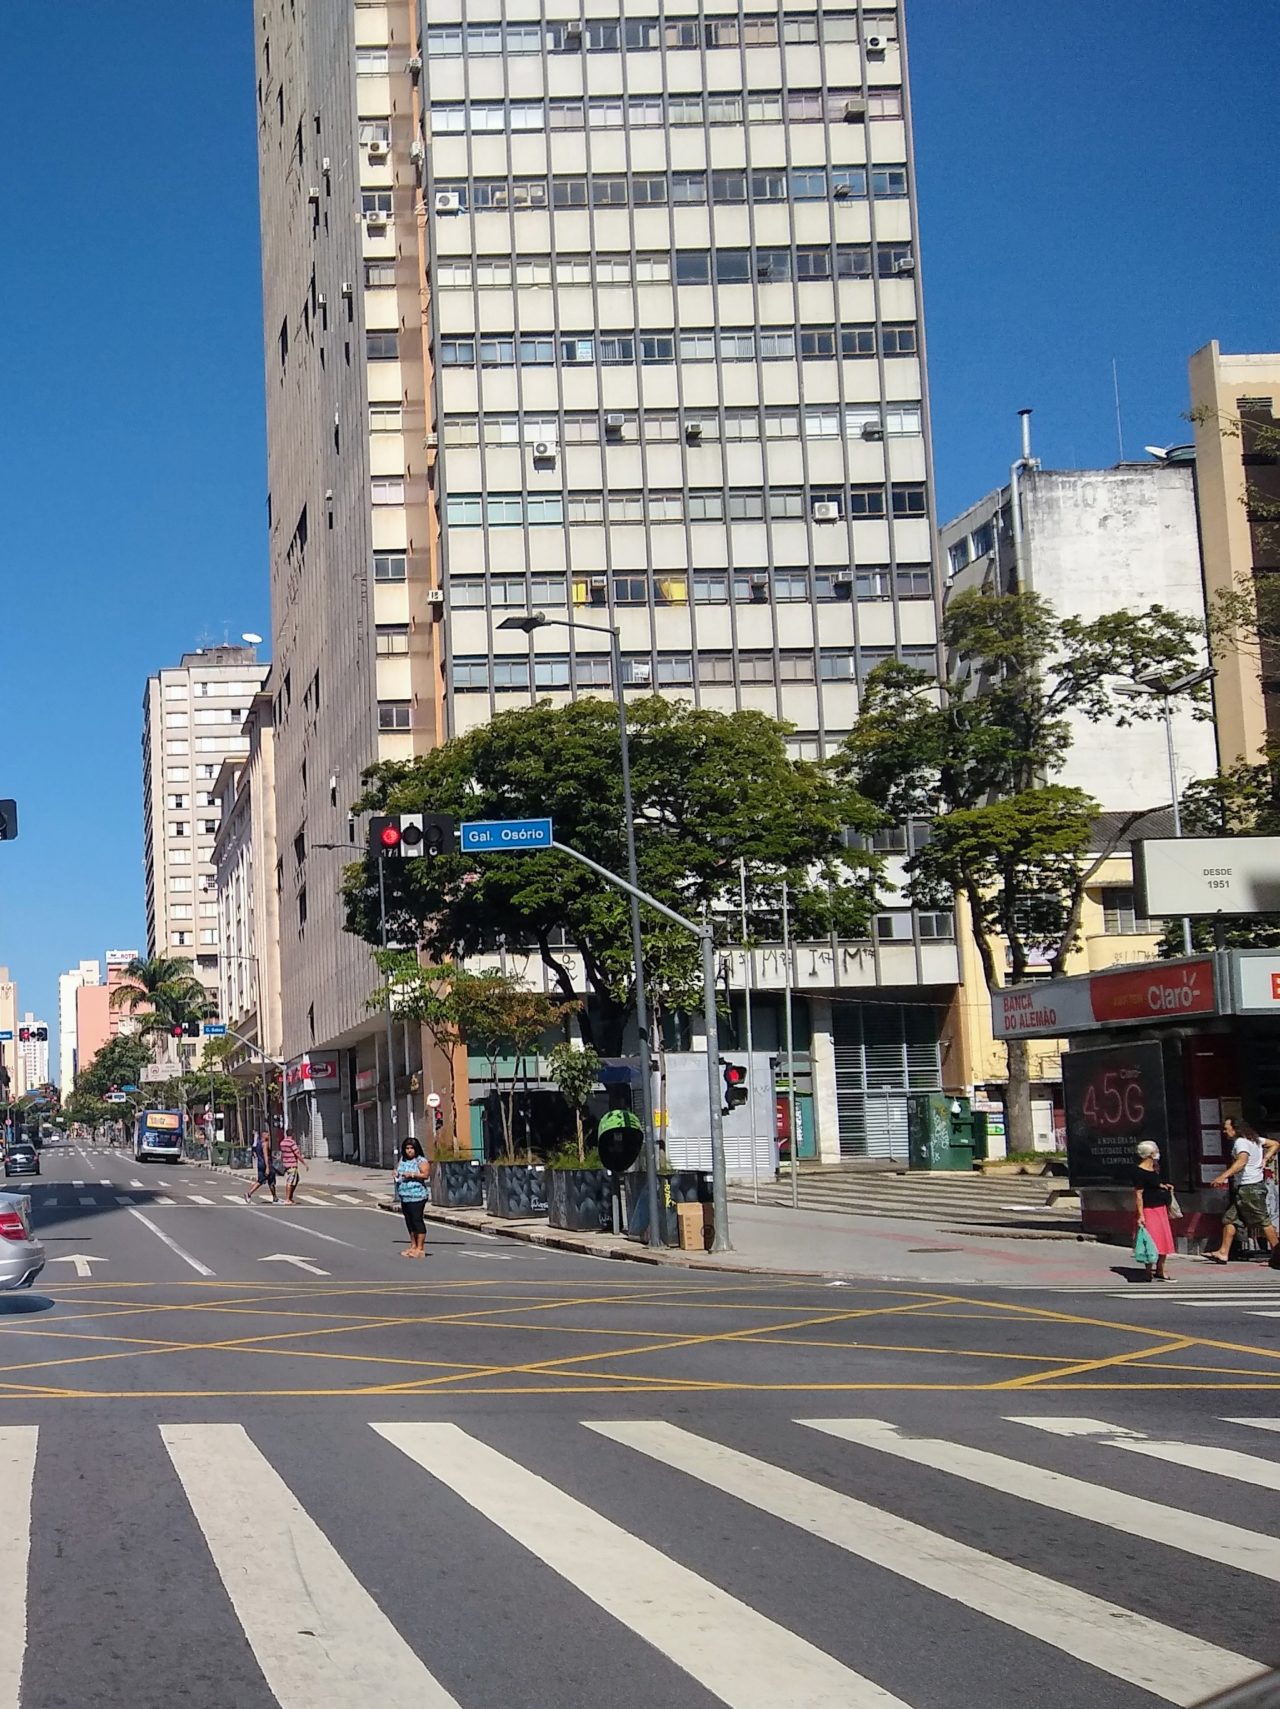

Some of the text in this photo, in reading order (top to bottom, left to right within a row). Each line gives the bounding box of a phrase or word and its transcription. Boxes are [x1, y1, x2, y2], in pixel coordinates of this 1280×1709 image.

[469, 828, 544, 843] Gal. Osório
[428, 846, 438, 856] C
[1203, 868, 1233, 876] DESDE
[1207, 880, 1230, 889] 1951
[1003, 994, 1033, 1013] BANCA
[1147, 981, 1194, 1011] Claro
[1004, 1008, 1057, 1030] DO ALEMÃO
[1083, 1071, 1145, 1125] 4.5G
